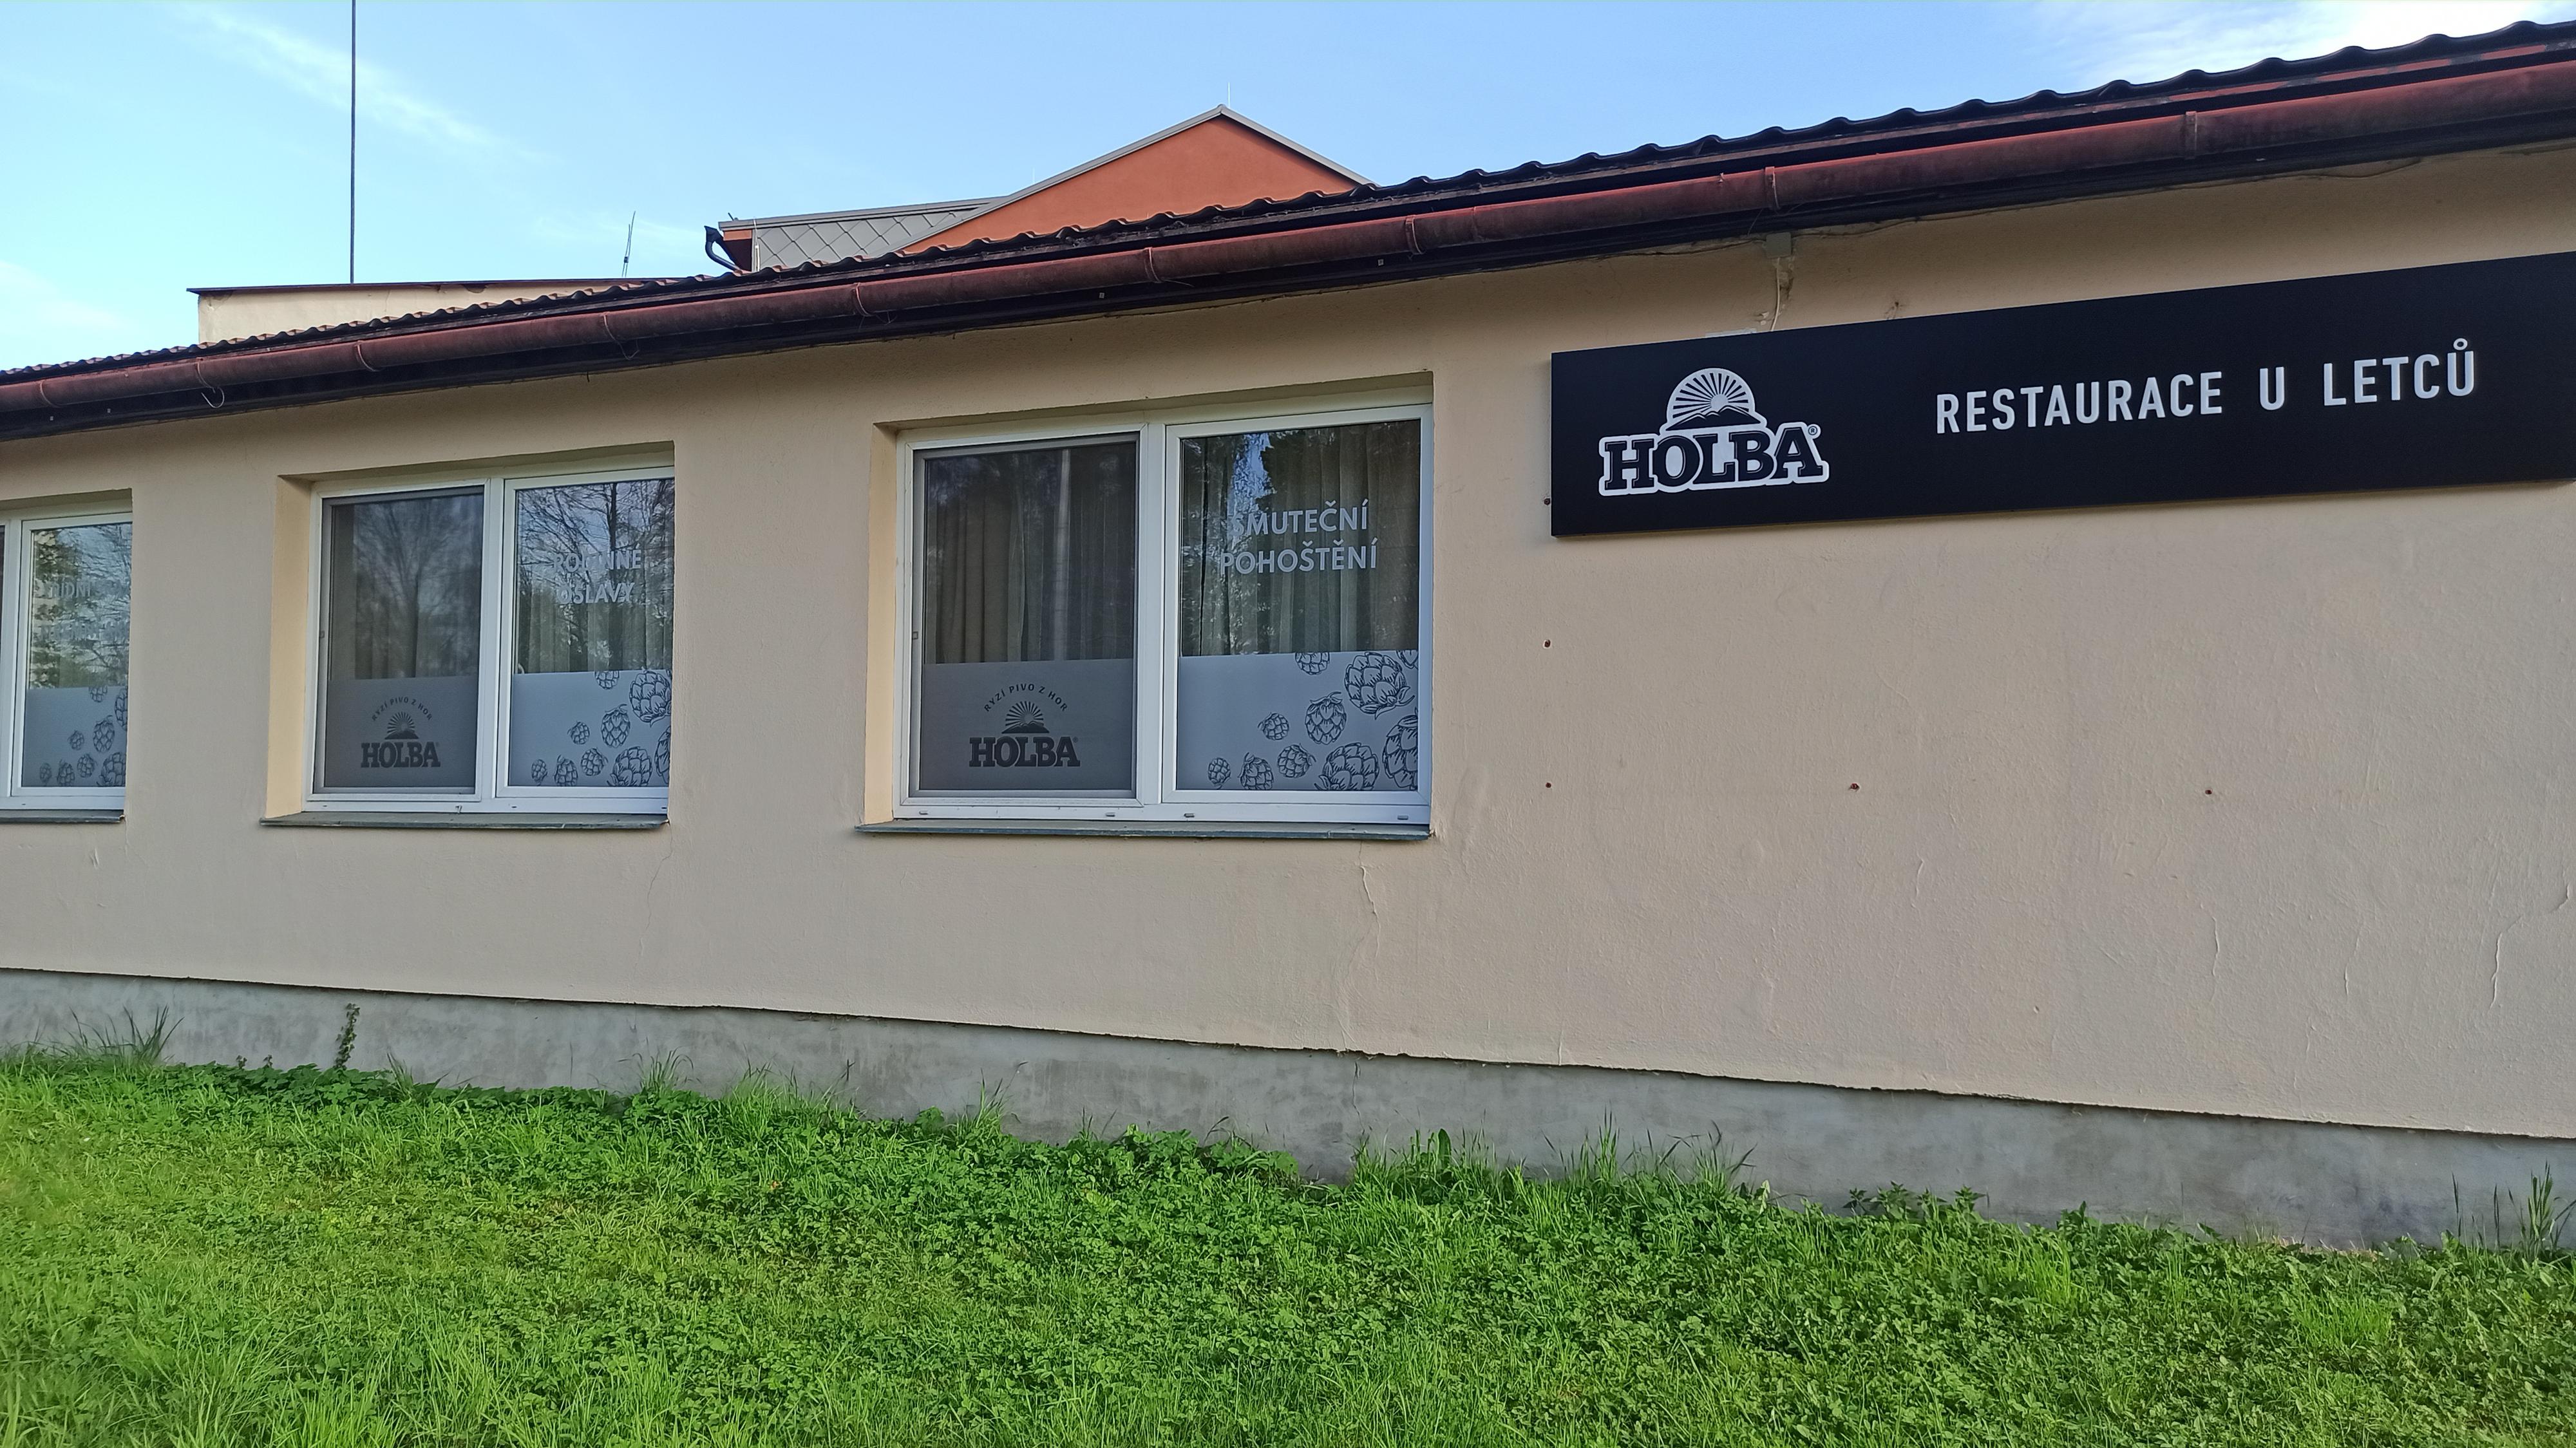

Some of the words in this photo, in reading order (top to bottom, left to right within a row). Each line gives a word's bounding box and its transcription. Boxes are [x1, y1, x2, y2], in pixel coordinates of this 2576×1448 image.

[1936, 370, 2223, 435] RESTAURACE
[2259, 365, 2286, 411] U
[2322, 337, 2475, 406] LETCŮ
[1230, 498, 1368, 536] SMUTEČNÍ
[1222, 538, 1378, 576] POHOŠTĚNÍ
[390, 697, 409, 706] PIVO
[418, 702, 432, 720] HOR
[1009, 683, 1035, 693] PIVO
[1038, 686, 1046, 694] Z
[1048, 691, 1068, 711] HOR
